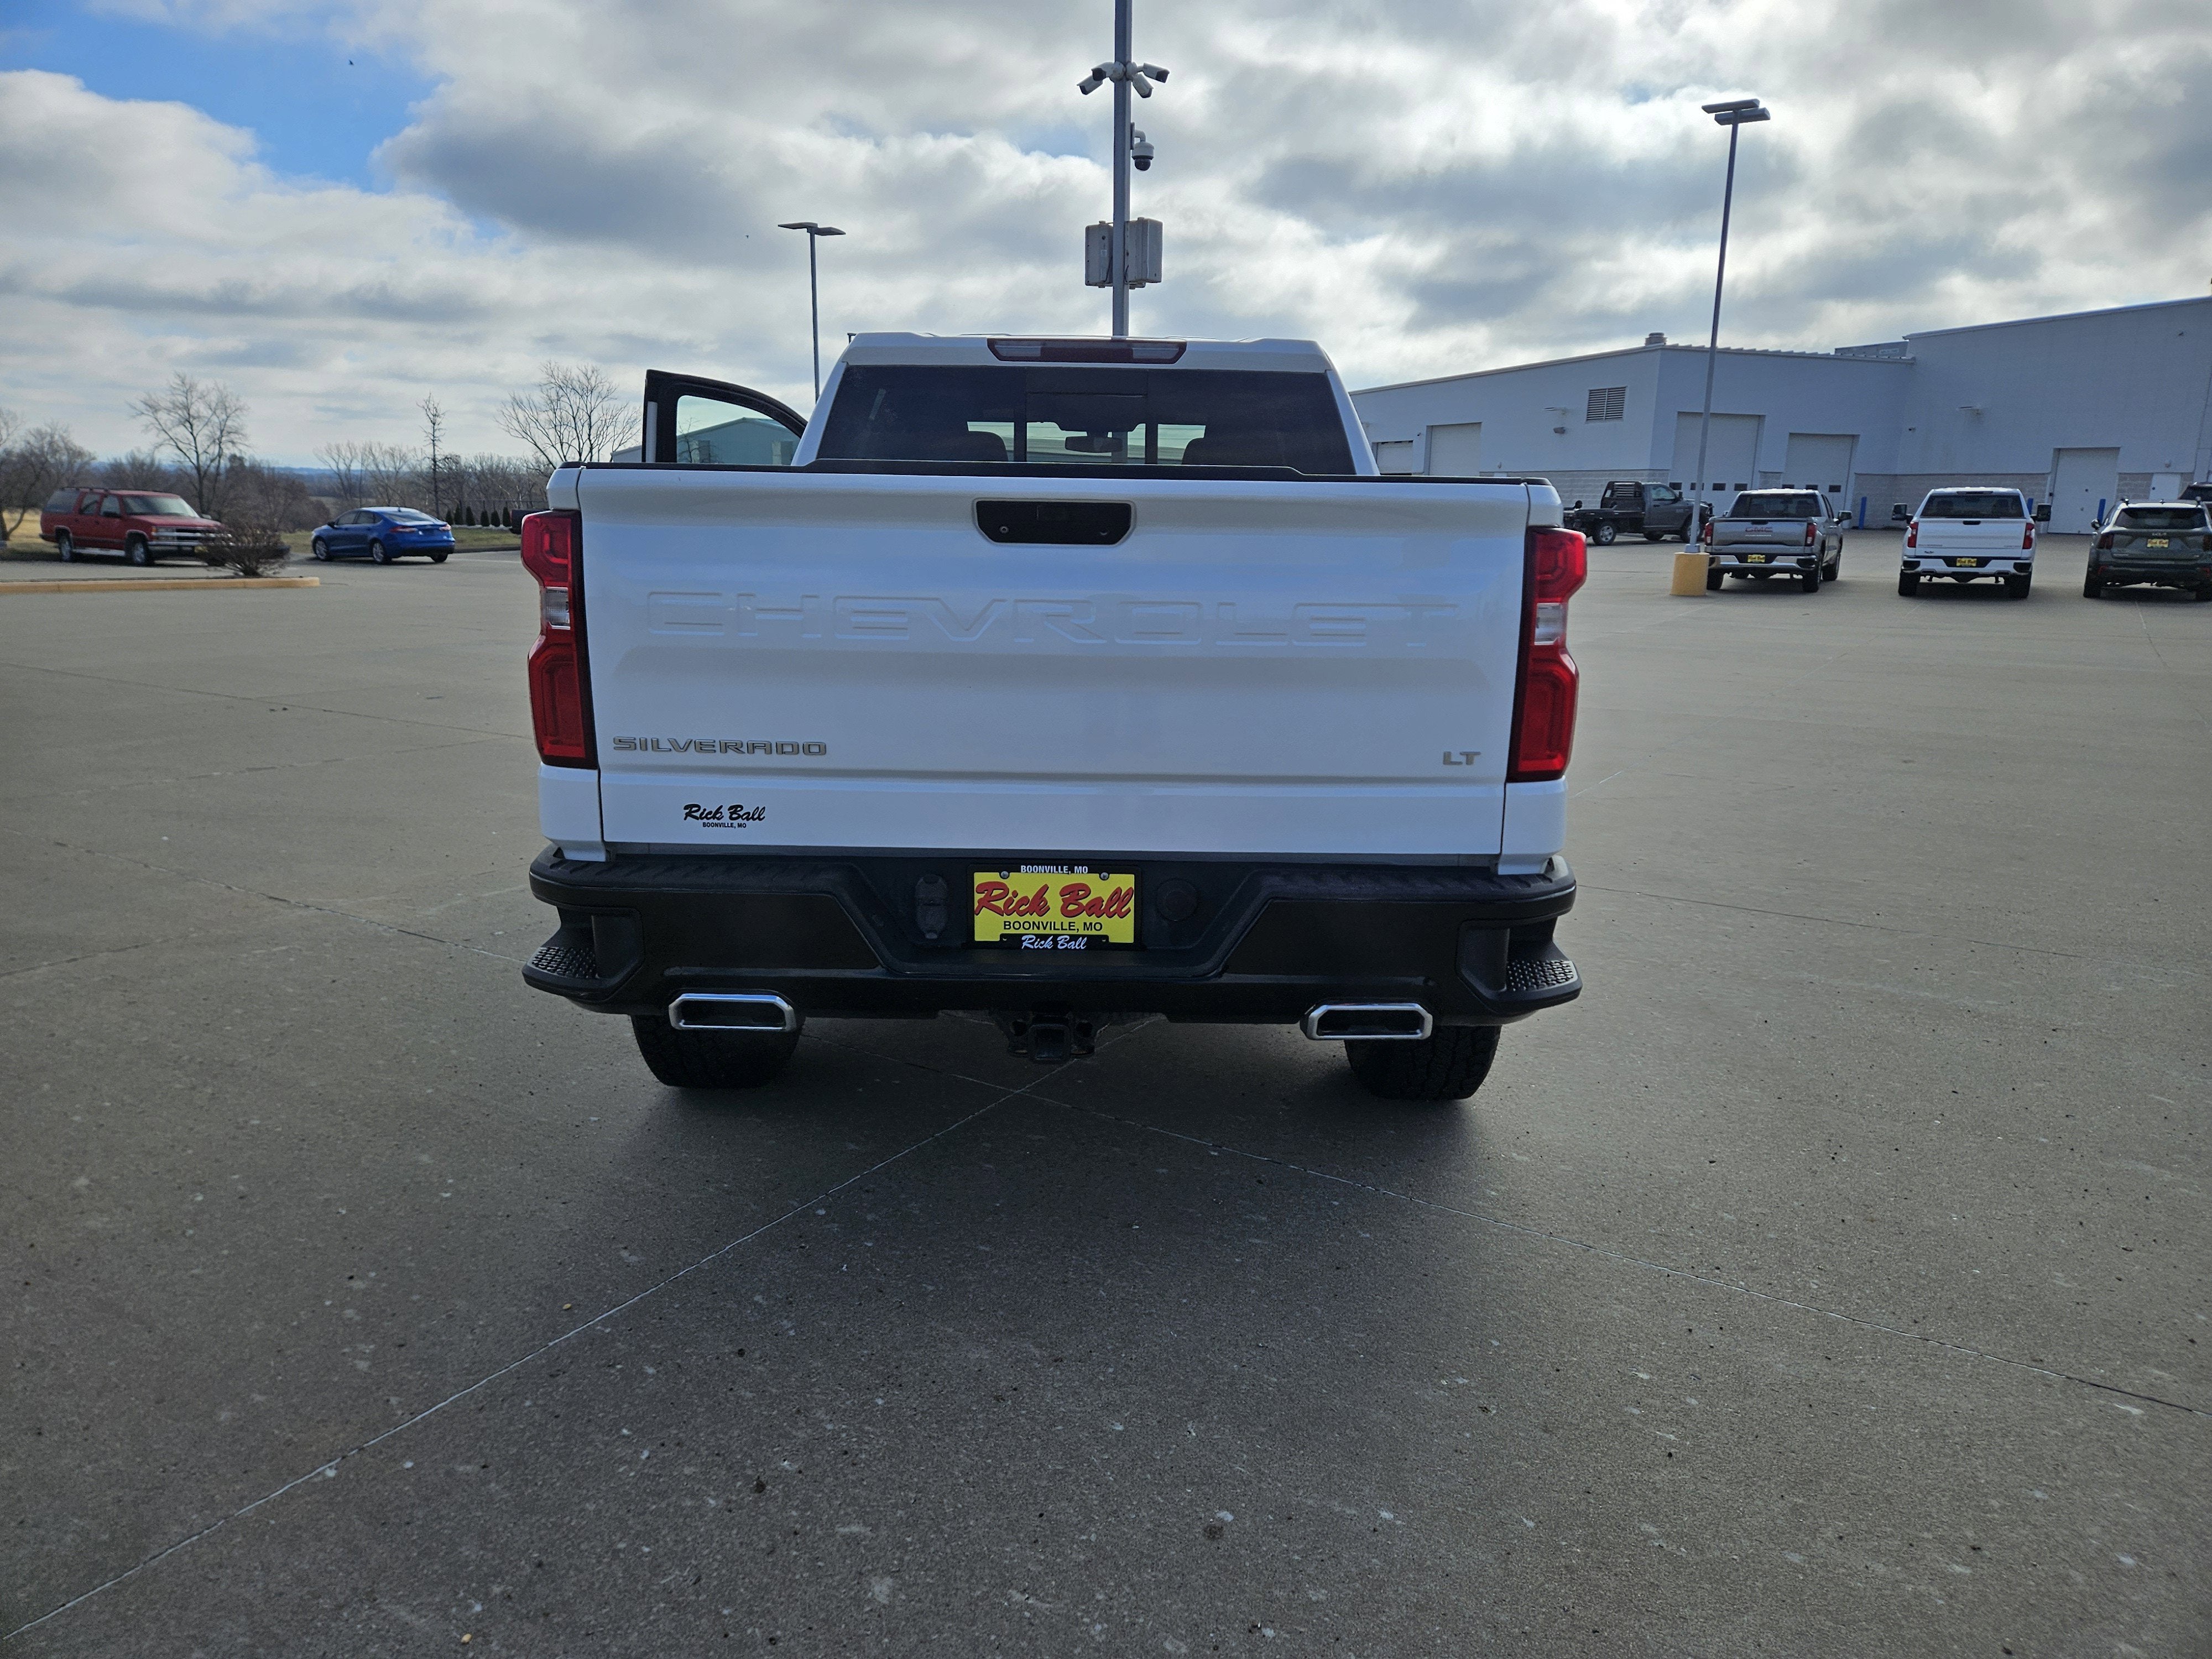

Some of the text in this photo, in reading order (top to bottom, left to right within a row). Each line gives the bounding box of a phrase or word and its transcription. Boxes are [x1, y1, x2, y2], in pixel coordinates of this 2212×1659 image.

[647, 591, 1458, 647] CHEVROLET
[613, 736, 827, 755] SILVERADO
[1443, 750, 1481, 766] LT
[684, 804, 766, 822] Rick Ball
[1021, 865, 1088, 874] BOONVILLE, MO
[974, 881, 1134, 919] Rick Ball
[1003, 921, 1103, 932] BOONVILLE, MO
[1021, 935, 1087, 950] Rick Ball
